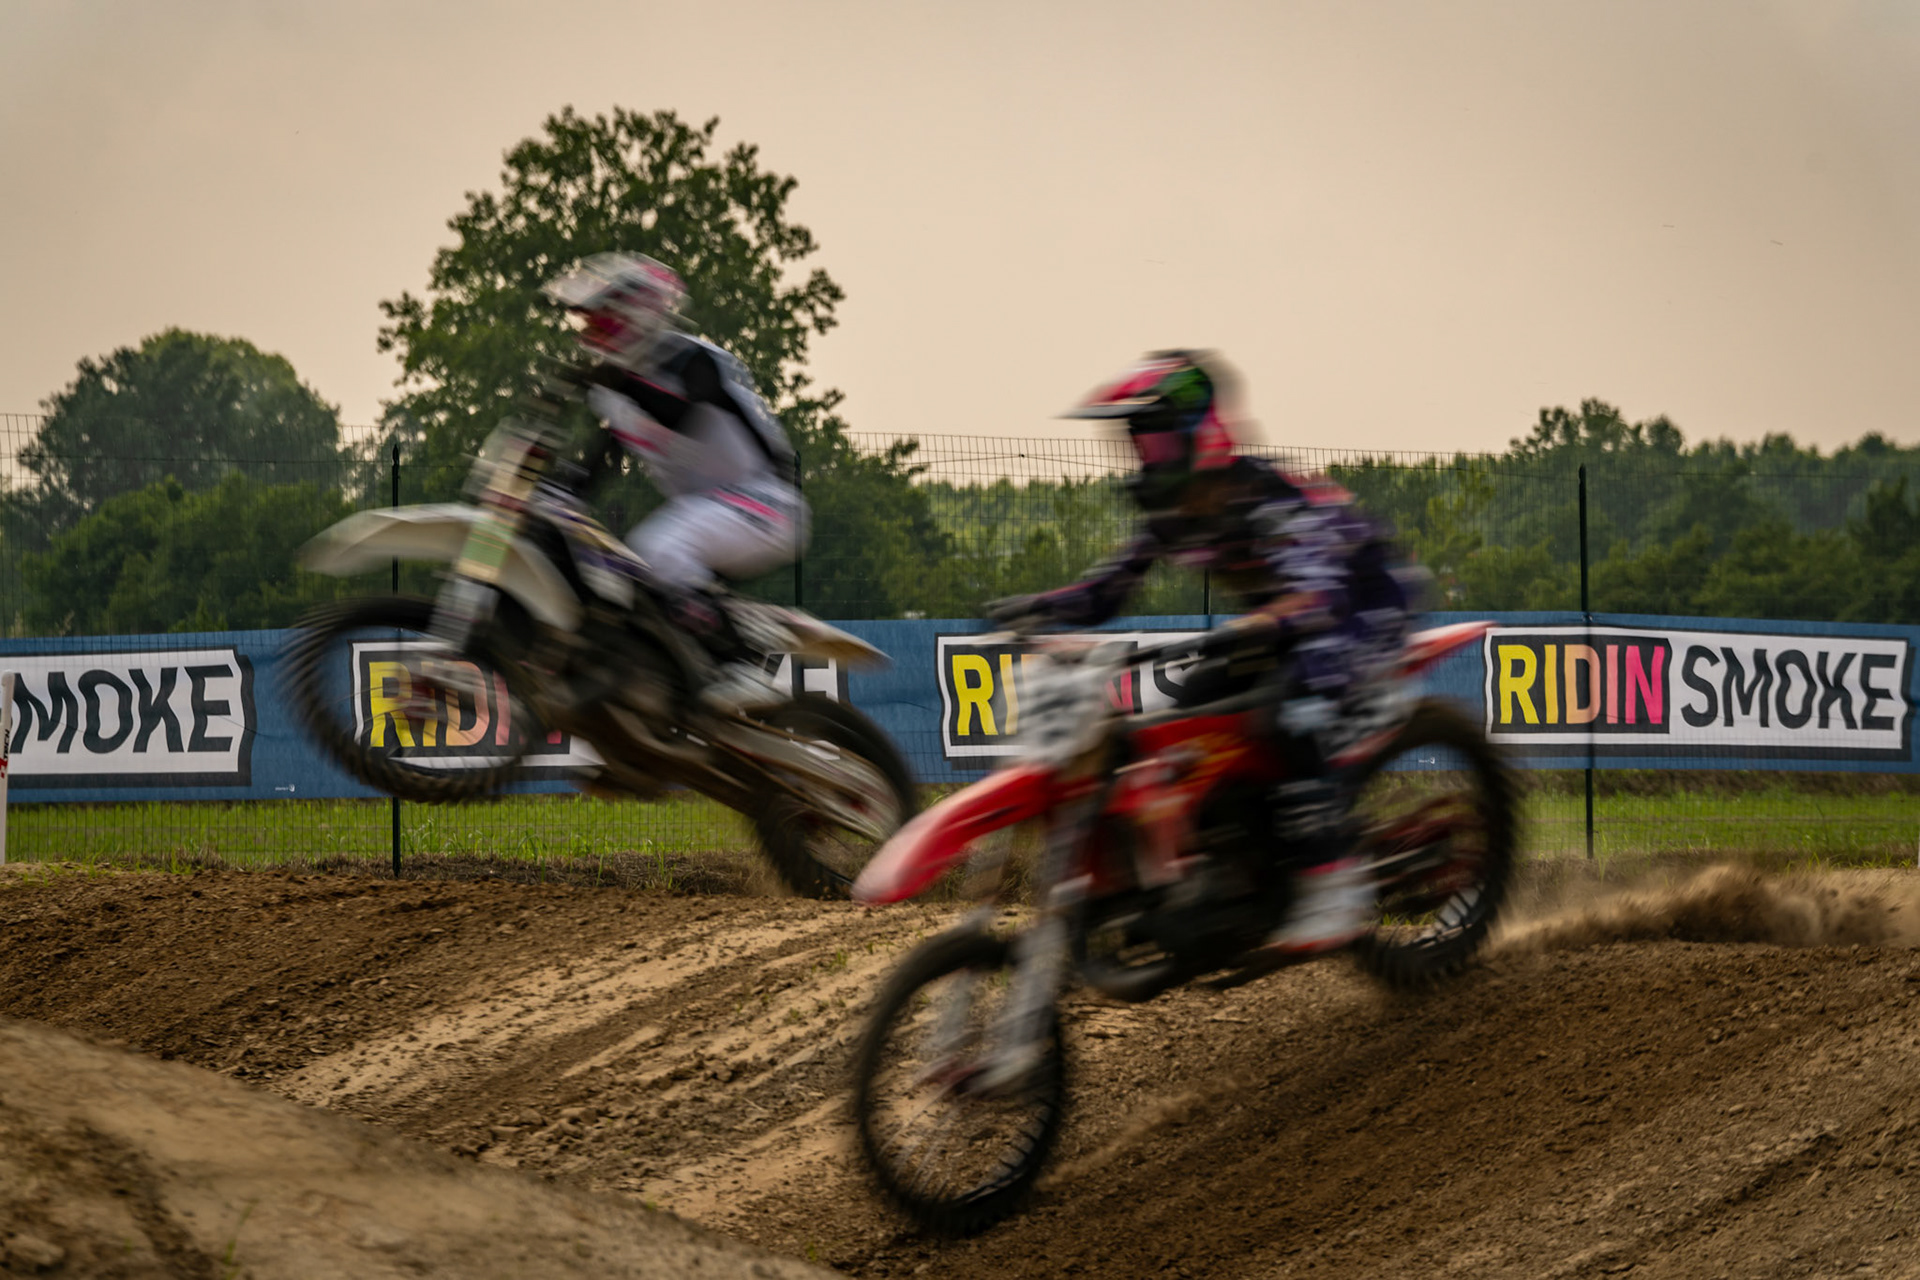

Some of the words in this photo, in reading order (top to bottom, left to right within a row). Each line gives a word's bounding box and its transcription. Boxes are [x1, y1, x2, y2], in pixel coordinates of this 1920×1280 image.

[0, 664, 234, 754] MOKE
[369, 661, 562, 747] RIDI
[1497, 644, 1665, 725] RIDIN
[1681, 645, 1897, 731] SMOKE
